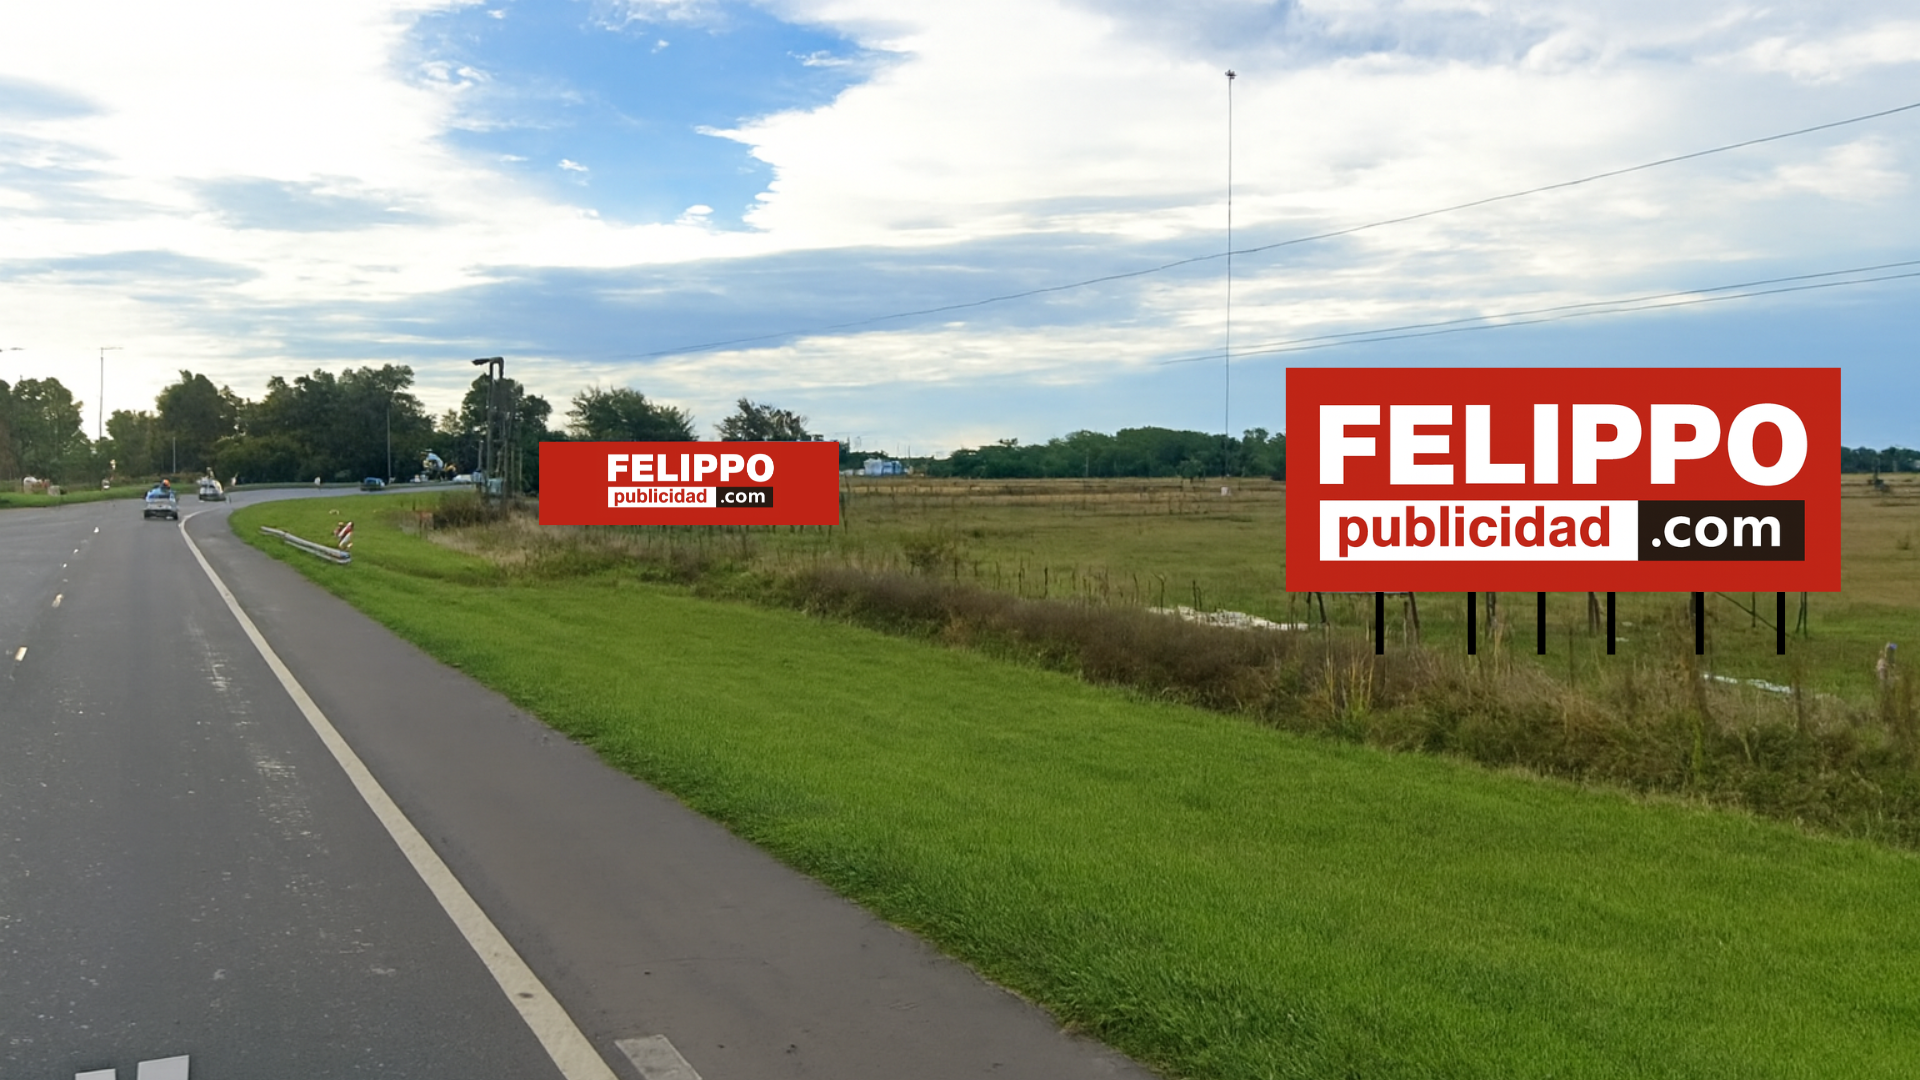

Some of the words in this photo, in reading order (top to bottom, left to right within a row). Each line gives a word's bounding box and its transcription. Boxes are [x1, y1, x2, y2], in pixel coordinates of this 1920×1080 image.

[1319, 403, 1808, 487] FELIPPO
[607, 453, 775, 483] FELIPPO
[613, 488, 707, 507] publicidad
[720, 490, 766, 504] .com
[1339, 505, 1610, 558] publicidad
[1651, 515, 1781, 548] .com
